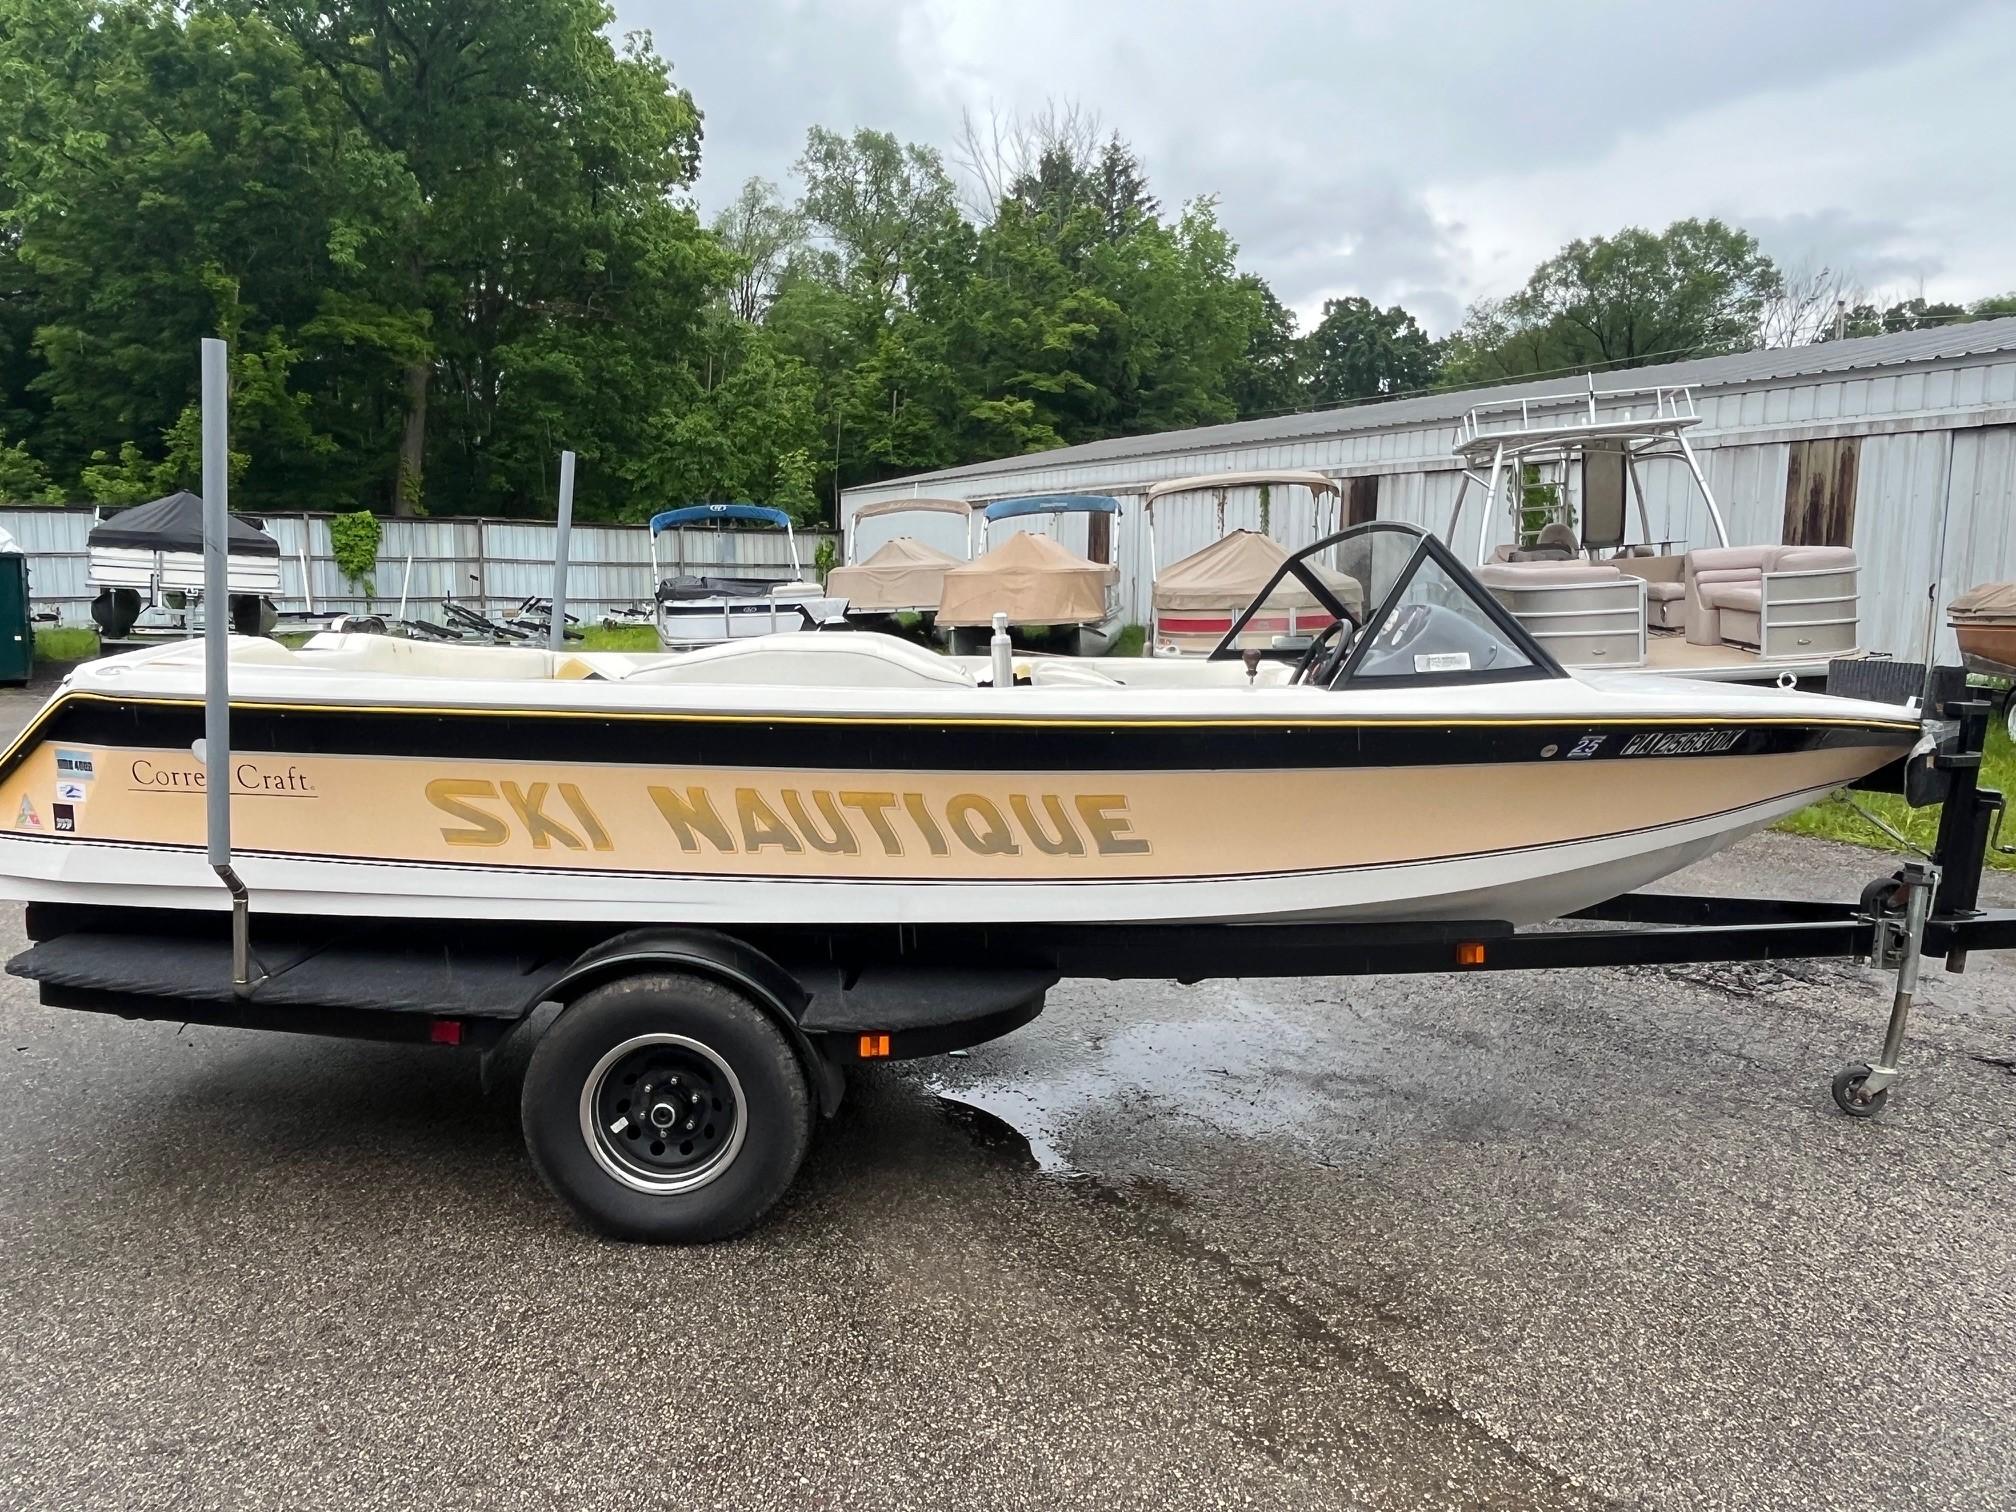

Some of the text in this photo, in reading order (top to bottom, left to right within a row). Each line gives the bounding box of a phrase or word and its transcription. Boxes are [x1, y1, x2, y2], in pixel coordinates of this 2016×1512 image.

[1572, 740, 1602, 753] 25
[132, 760, 206, 786] Corre
[424, 779, 1152, 857] SKI NAUTIQUE
